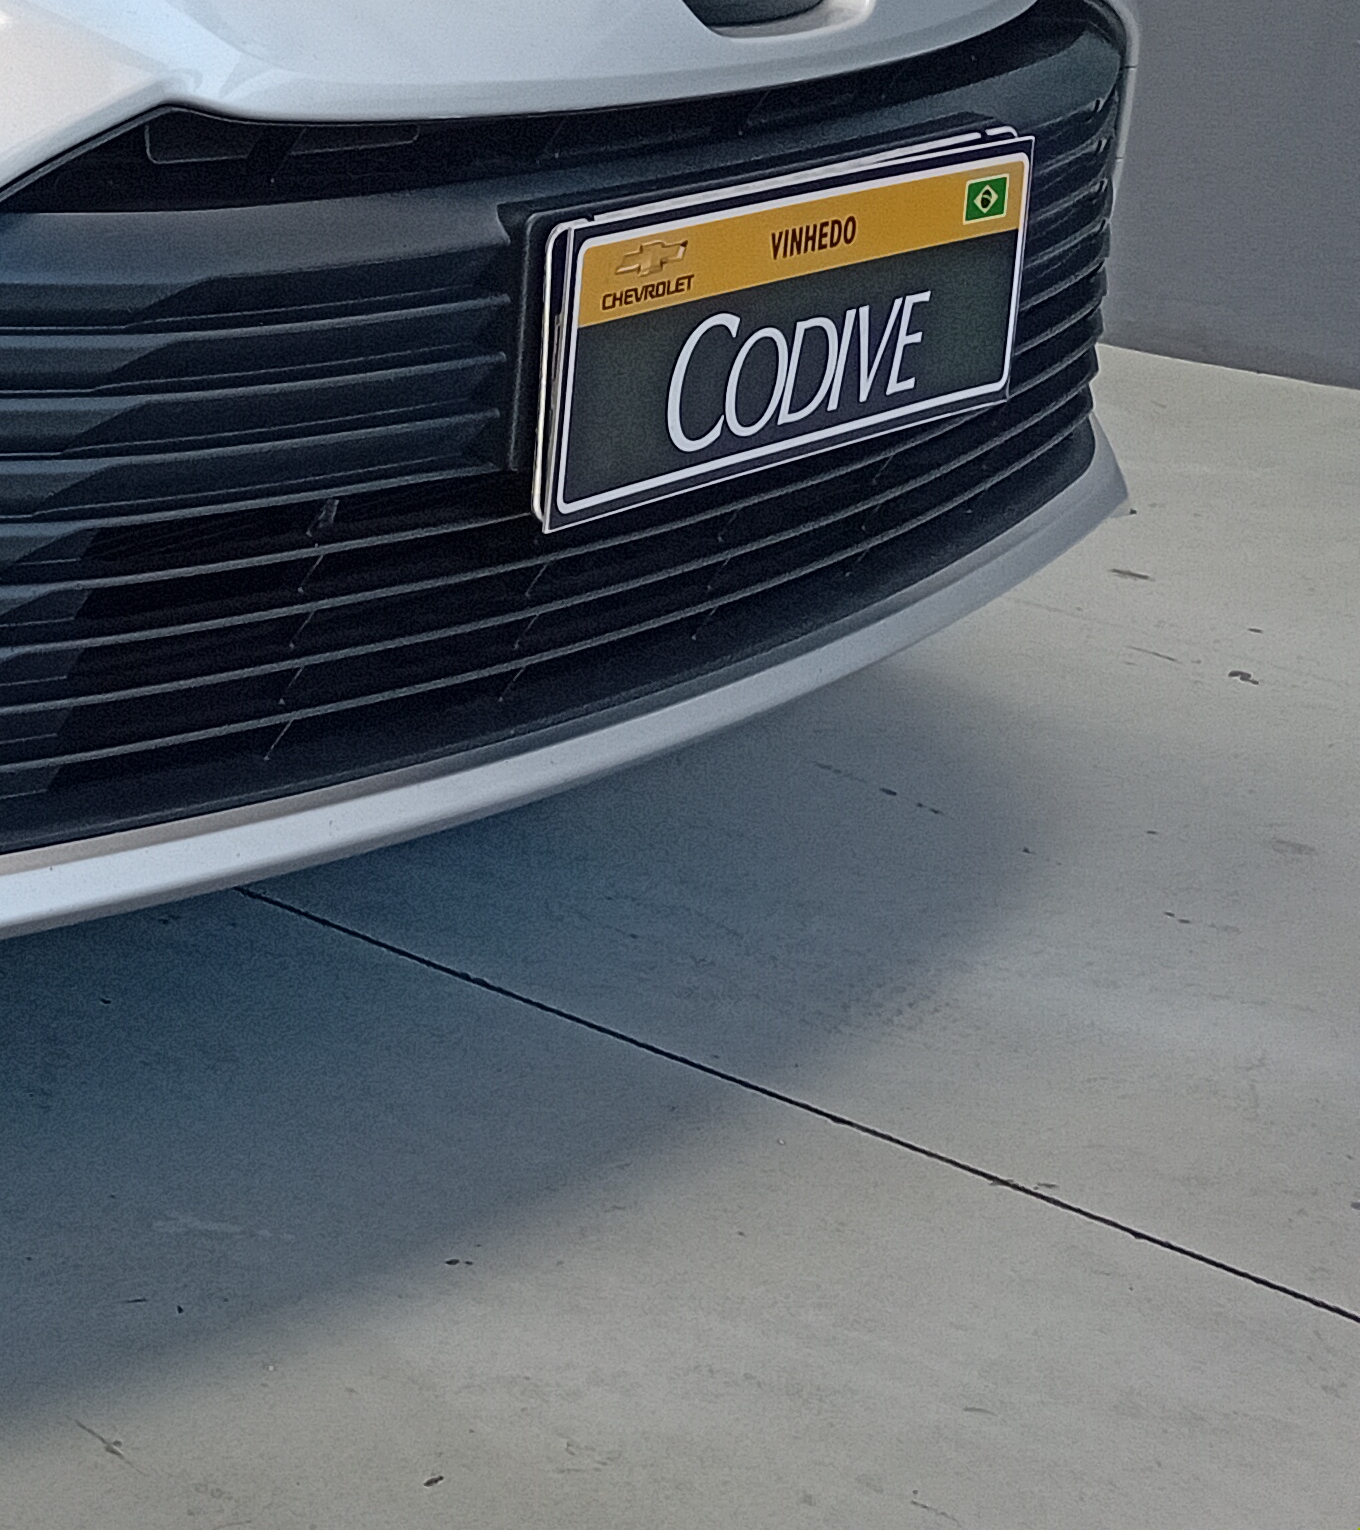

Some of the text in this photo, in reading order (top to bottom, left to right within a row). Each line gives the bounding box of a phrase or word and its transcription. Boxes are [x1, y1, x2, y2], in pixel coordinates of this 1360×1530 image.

[770, 215, 857, 261] VINHEDO
[601, 274, 695, 311] CHEVROLET
[666, 290, 932, 453] CODIVE
